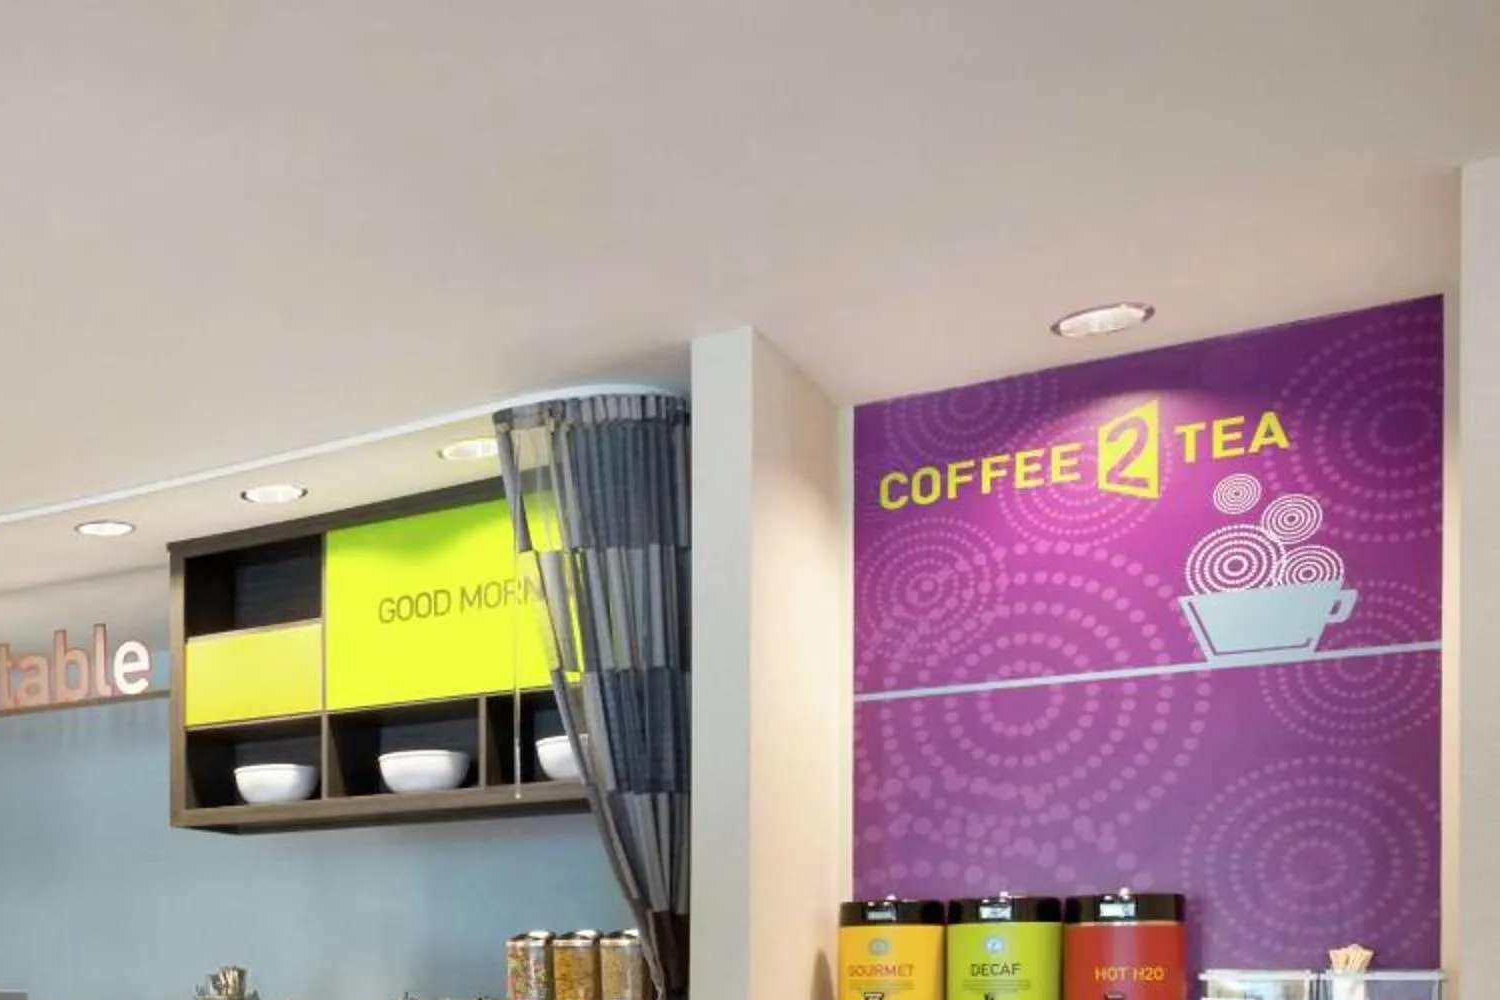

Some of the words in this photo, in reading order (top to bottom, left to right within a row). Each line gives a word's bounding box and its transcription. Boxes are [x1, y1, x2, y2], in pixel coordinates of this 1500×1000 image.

[879, 442, 1084, 510] COFFEE
[1175, 410, 1290, 463] TEA
[378, 588, 452, 624] GOOD
[847, 963, 915, 978] GOURMET
[970, 962, 1021, 977] DECAF
[1094, 966, 1128, 981] HOT
